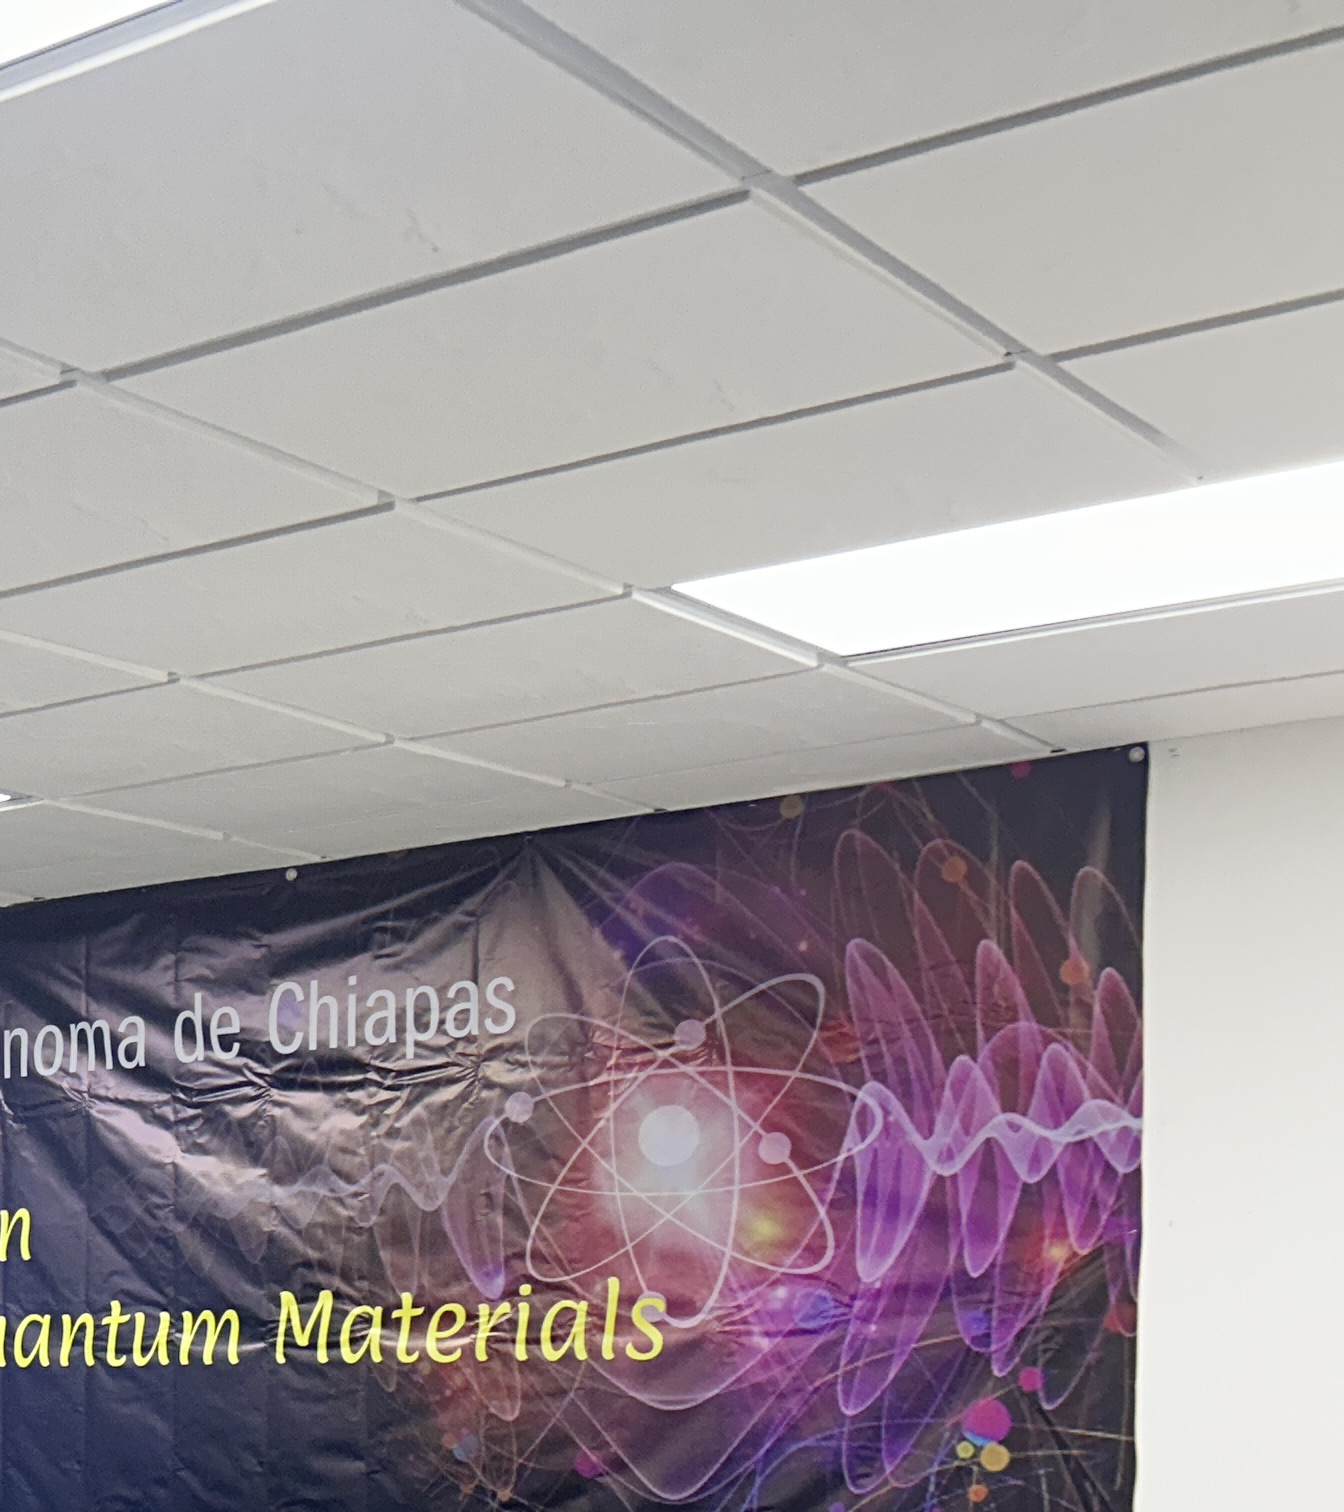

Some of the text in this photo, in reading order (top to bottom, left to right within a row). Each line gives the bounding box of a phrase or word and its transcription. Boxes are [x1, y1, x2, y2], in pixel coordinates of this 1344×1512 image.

[174, 993, 241, 1064] de
[268, 975, 516, 1059] Chiapas
[272, 1276, 667, 1366] Materials
